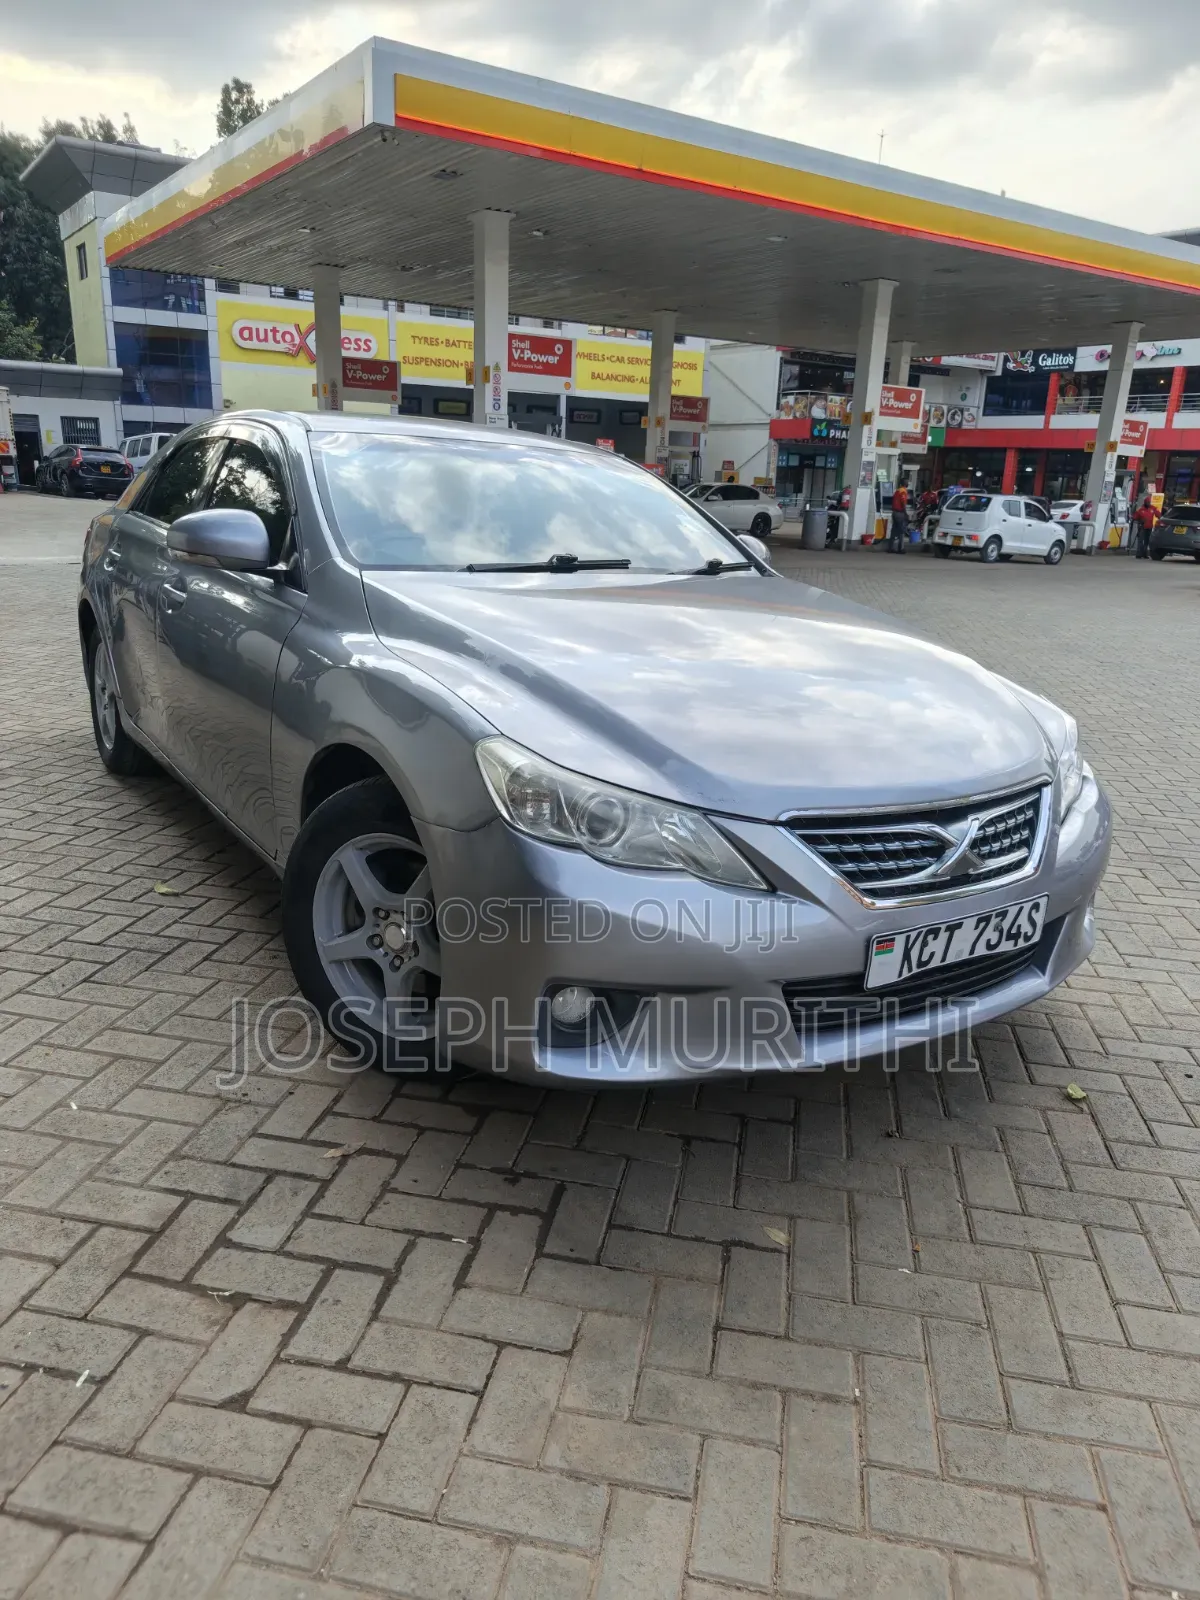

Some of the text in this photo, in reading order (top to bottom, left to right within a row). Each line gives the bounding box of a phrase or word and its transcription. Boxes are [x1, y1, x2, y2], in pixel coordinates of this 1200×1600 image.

[238, 322, 373, 364] autoXess
[411, 335, 473, 350] TYRES BATTE
[511, 339, 530, 349] Shell
[402, 355, 460, 369] SUSPENSION
[511, 349, 560, 364] V-Power
[609, 355, 626, 364] CAR
[627, 356, 651, 366] SERVIC
[672, 361, 698, 371] GNOSIS
[1038, 352, 1075, 367] Galito's
[345, 362, 362, 370] Shell
[346, 369, 387, 382] V-Power
[591, 371, 636, 384] BALANCING
[672, 405, 701, 414] V-Power
[881, 397, 913, 409] V-Power
[898, 901, 1041, 979] KCT 734S
